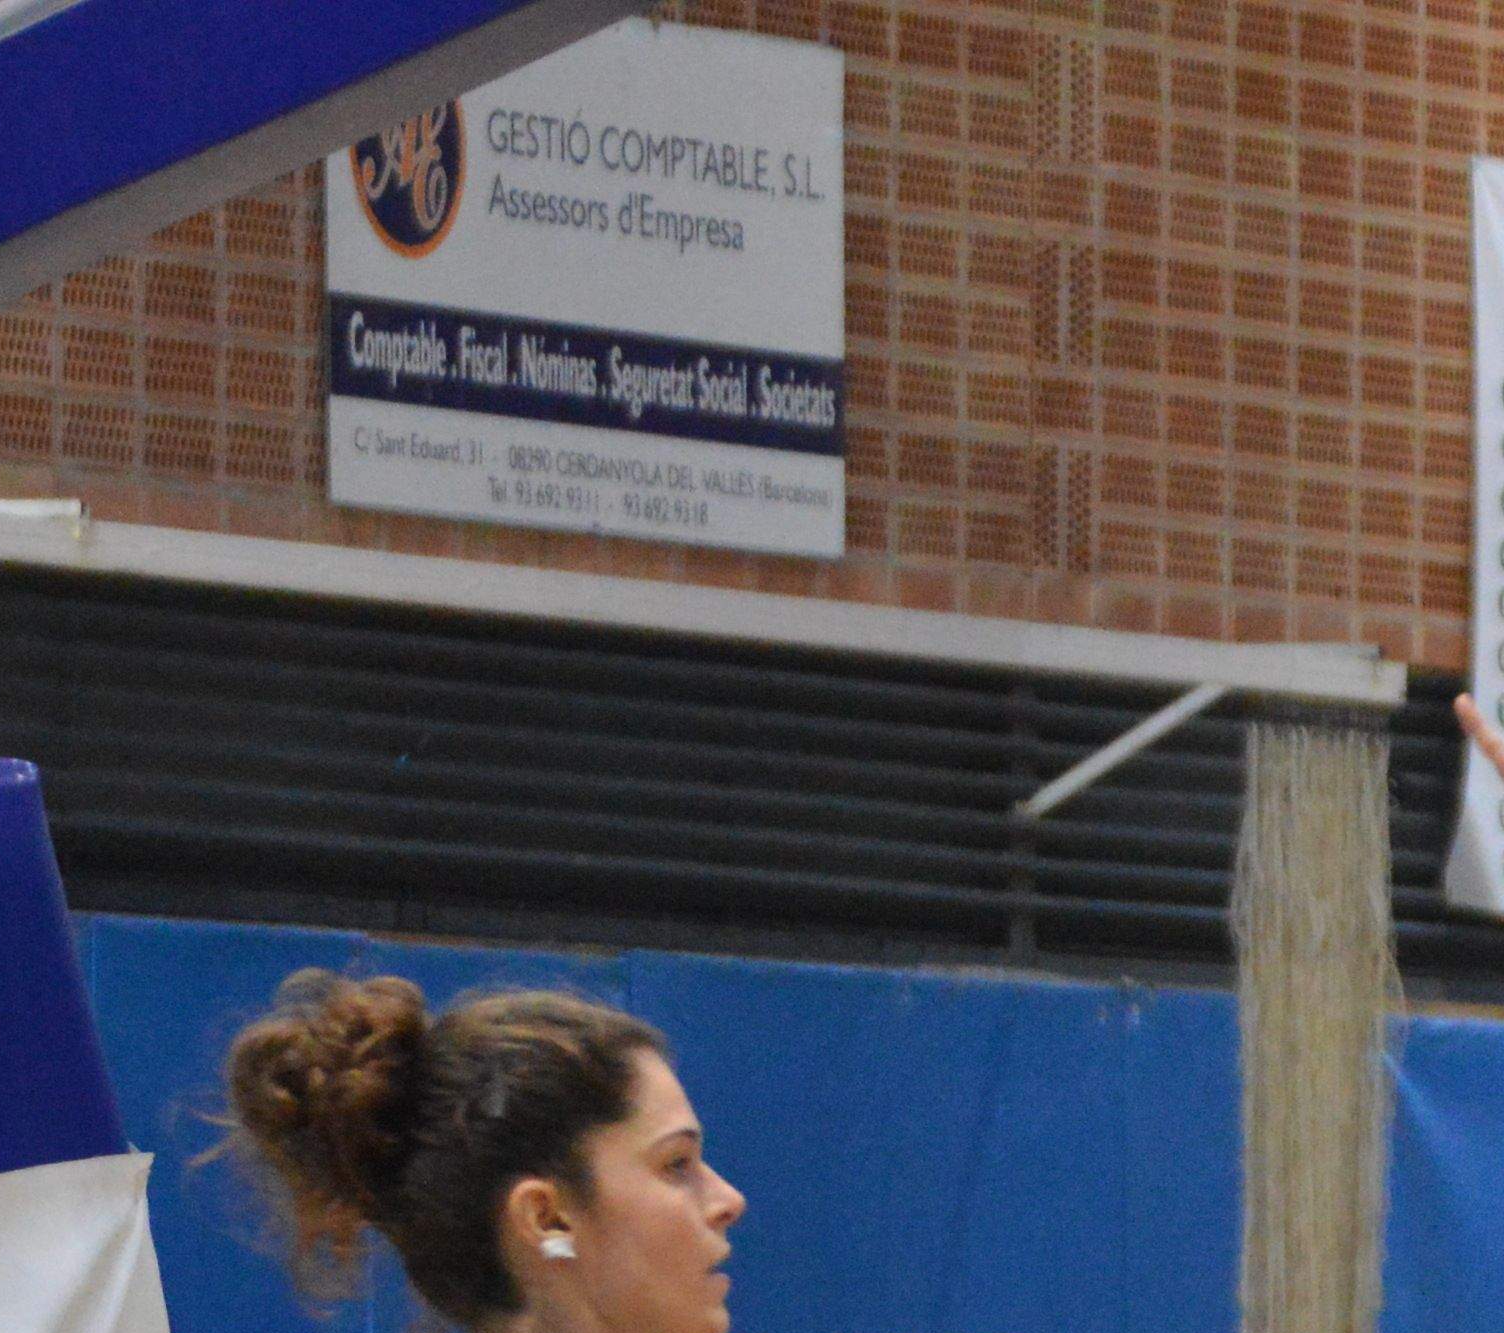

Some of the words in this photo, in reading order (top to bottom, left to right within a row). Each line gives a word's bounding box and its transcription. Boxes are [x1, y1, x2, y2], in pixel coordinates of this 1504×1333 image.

[485, 109, 591, 165] GESTIÓ
[782, 154, 826, 200] S.L.
[488, 175, 609, 234] Assessors
[618, 194, 745, 252] d'Empresa
[349, 310, 448, 388] Comptable
[460, 325, 508, 386] Fiscal
[698, 356, 748, 417] Social
[760, 364, 837, 428] Societats
